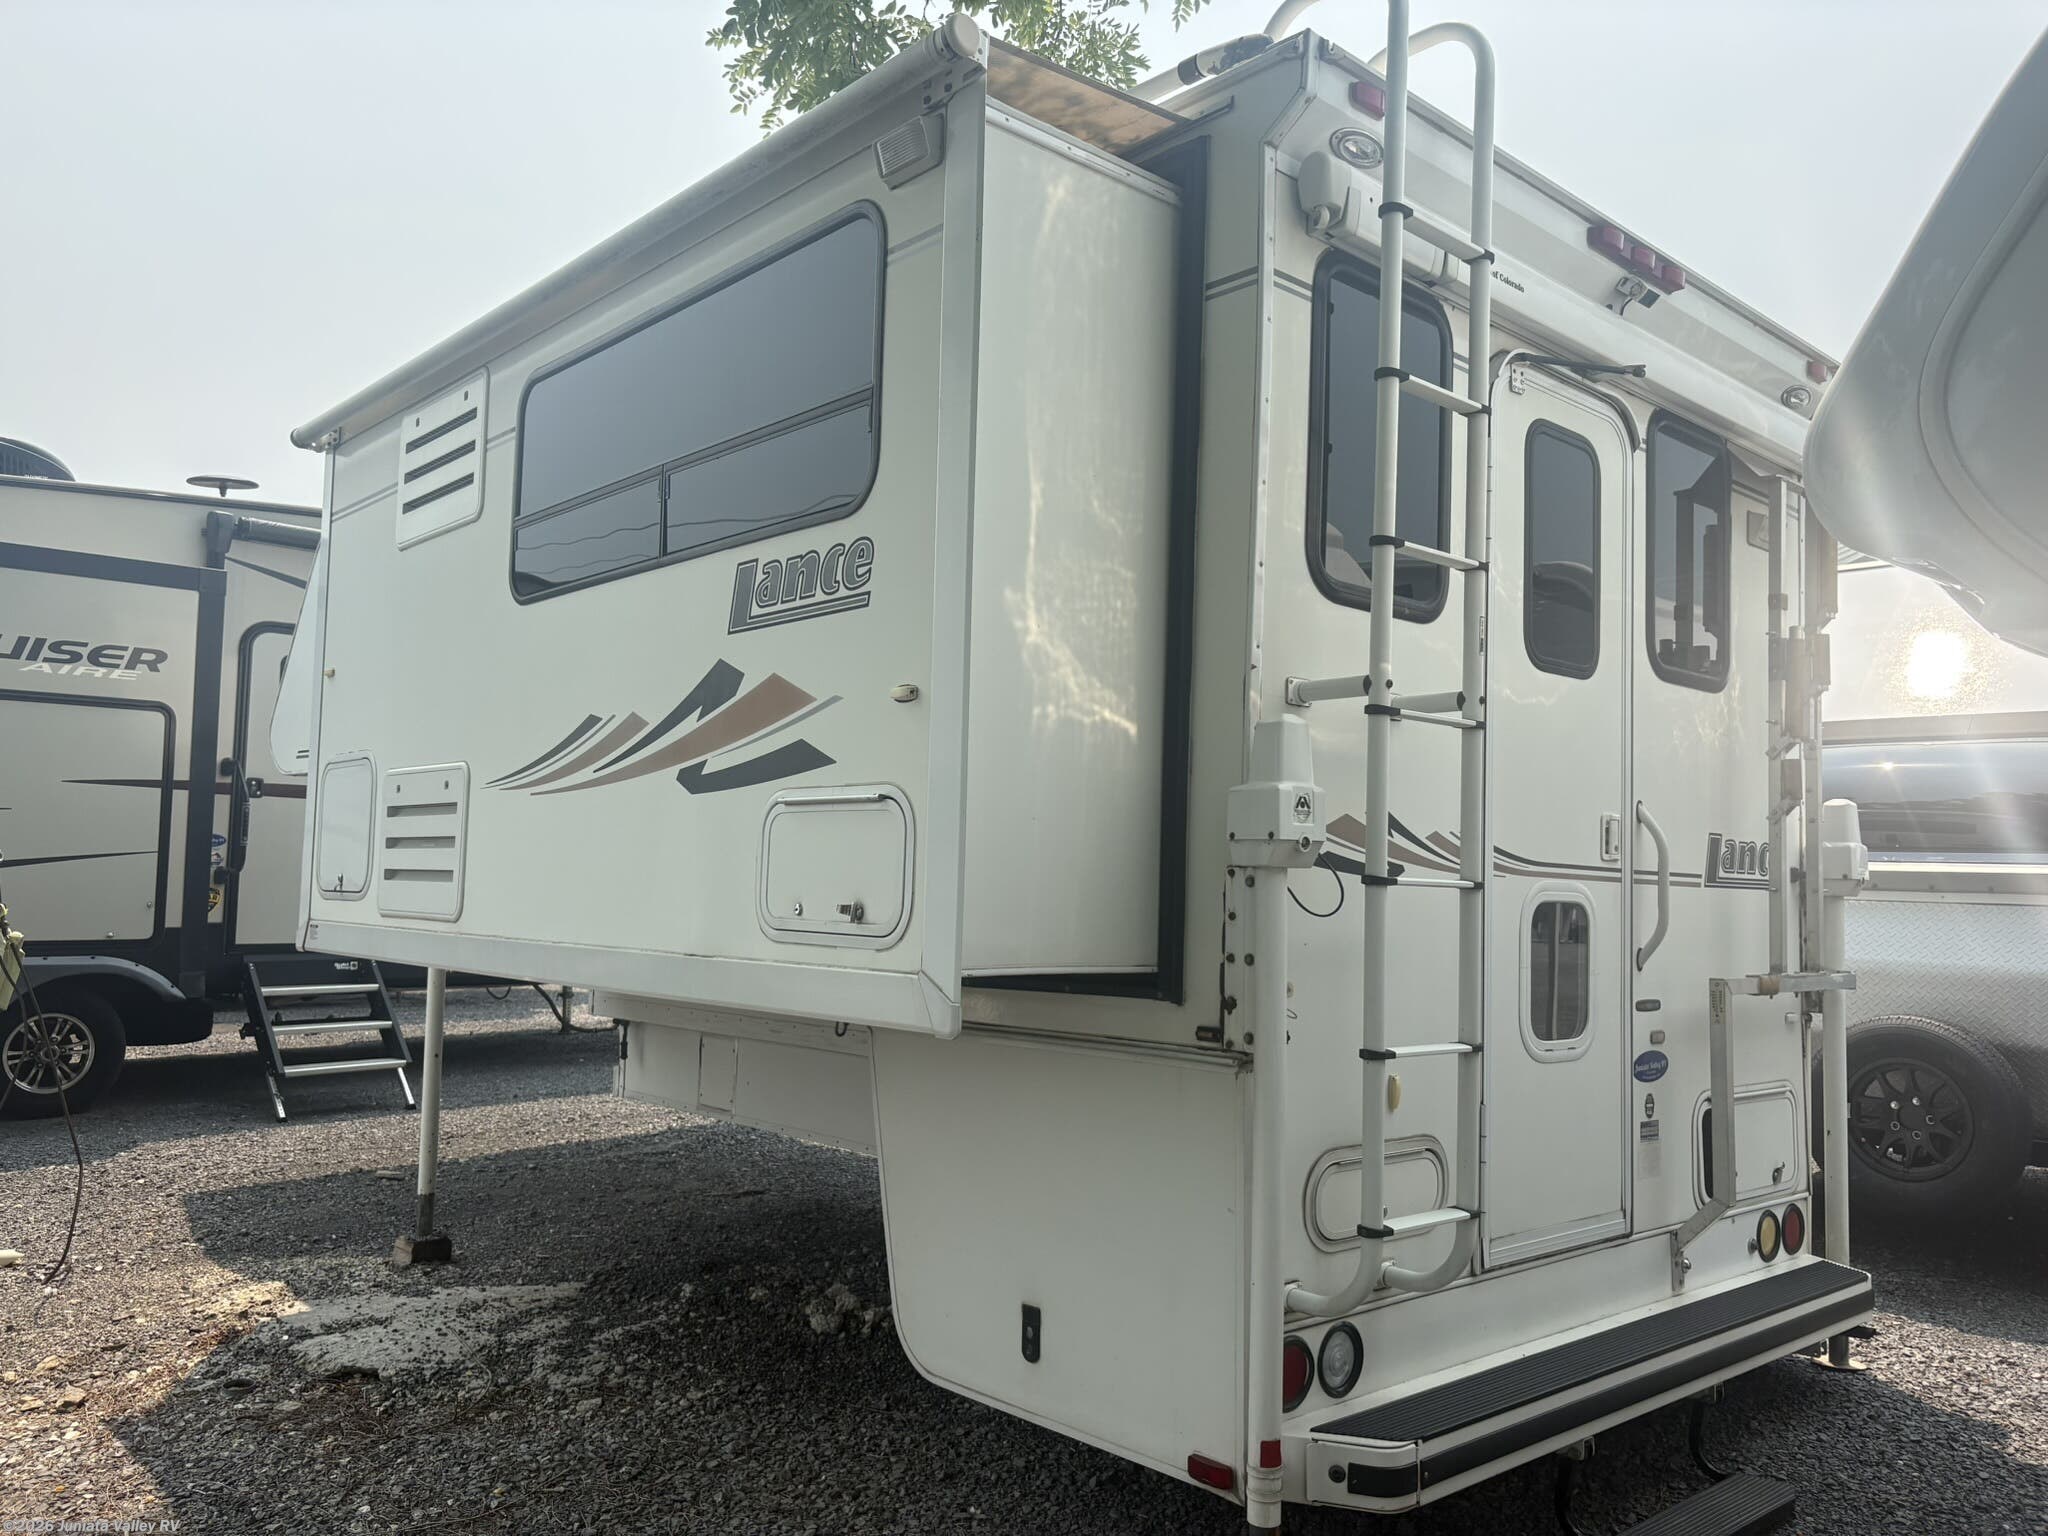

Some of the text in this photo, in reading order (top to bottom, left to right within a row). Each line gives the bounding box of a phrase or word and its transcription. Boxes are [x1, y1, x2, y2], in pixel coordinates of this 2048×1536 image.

[1500, 273, 1525, 293] Colorado
[728, 536, 874, 635] Lance
[18, 662, 142, 681] AIRE
[1704, 832, 1769, 889] Lanc
